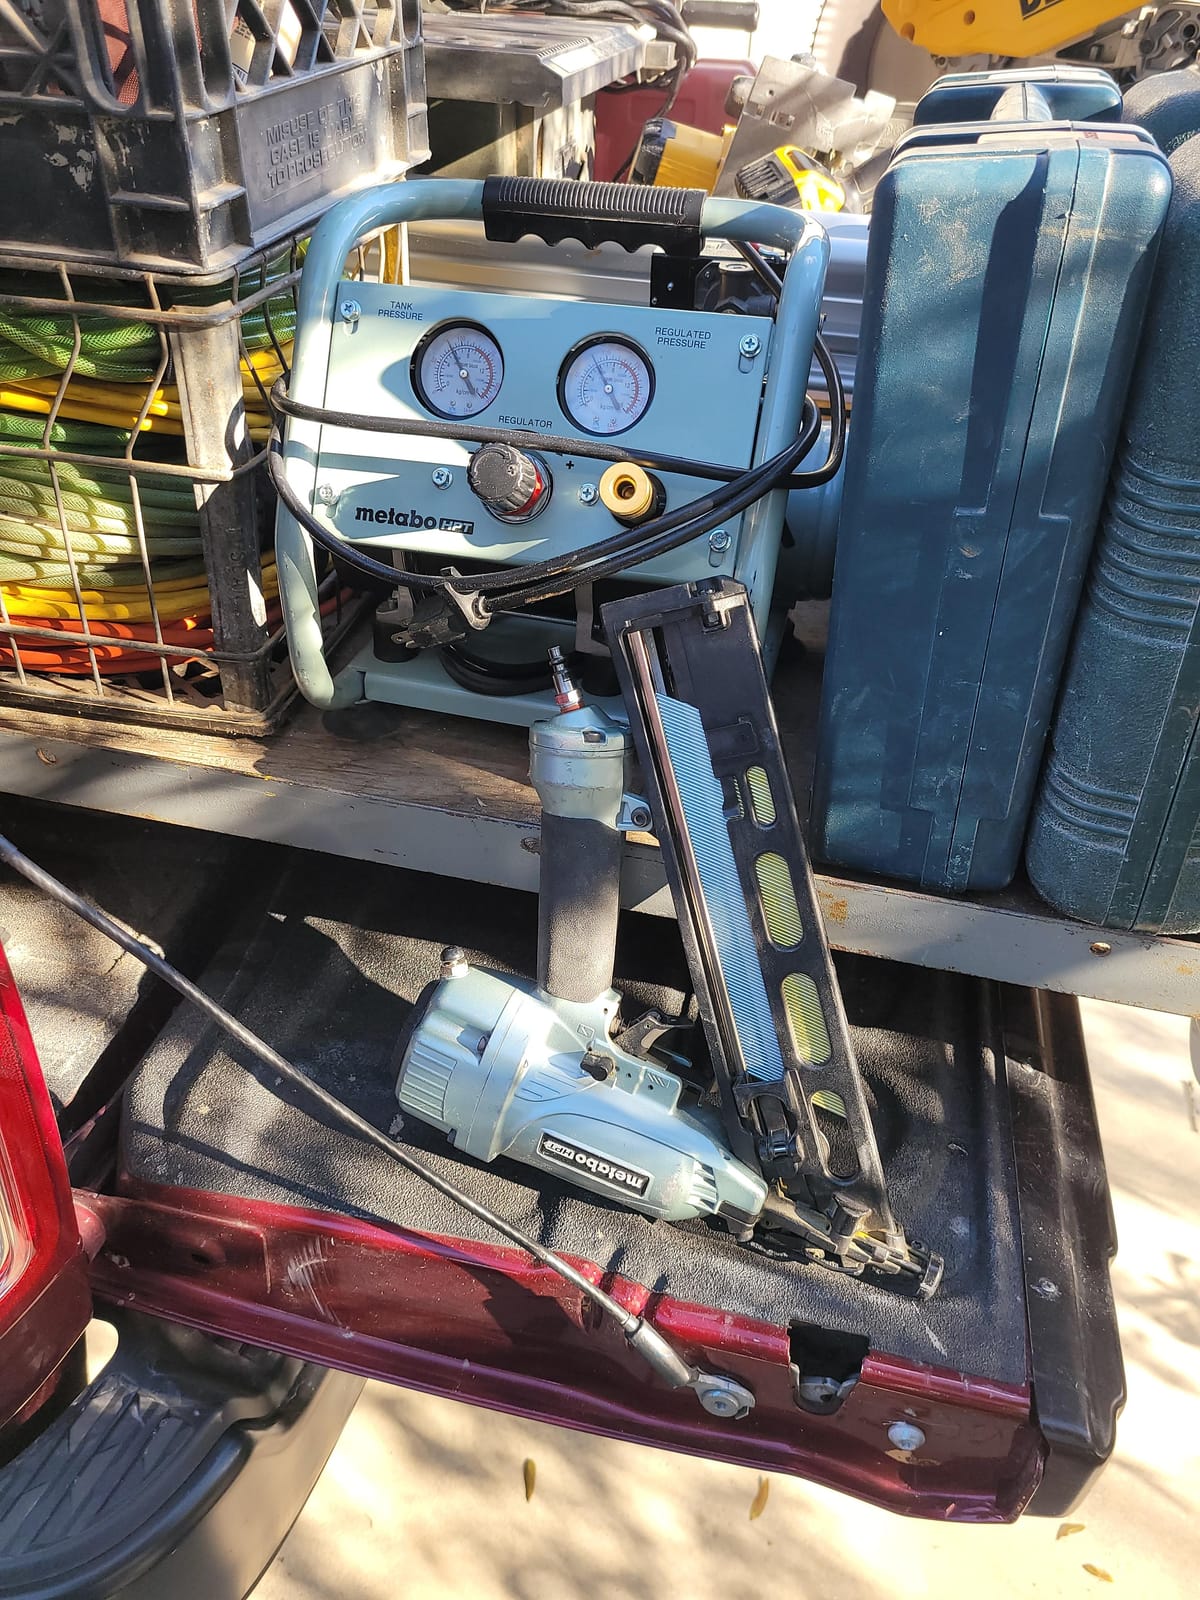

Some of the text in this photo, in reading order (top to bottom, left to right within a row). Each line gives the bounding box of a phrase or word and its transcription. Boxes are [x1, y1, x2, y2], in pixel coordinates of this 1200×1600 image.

[266, 110, 314, 146] MISUSE
[317, 104, 335, 126] OF
[270, 136, 306, 166] CASE
[308, 129, 321, 151] IS
[267, 166, 286, 189] TO
[377, 308, 424, 321] PRESSURE
[389, 300, 414, 311] TANK
[655, 326, 712, 340] REGULATED
[656, 336, 707, 349] PRESSURE
[498, 415, 553, 429] REGULATOR
[355, 507, 475, 534] metabo HPT
[544, 1141, 644, 1189] metabo HPT
